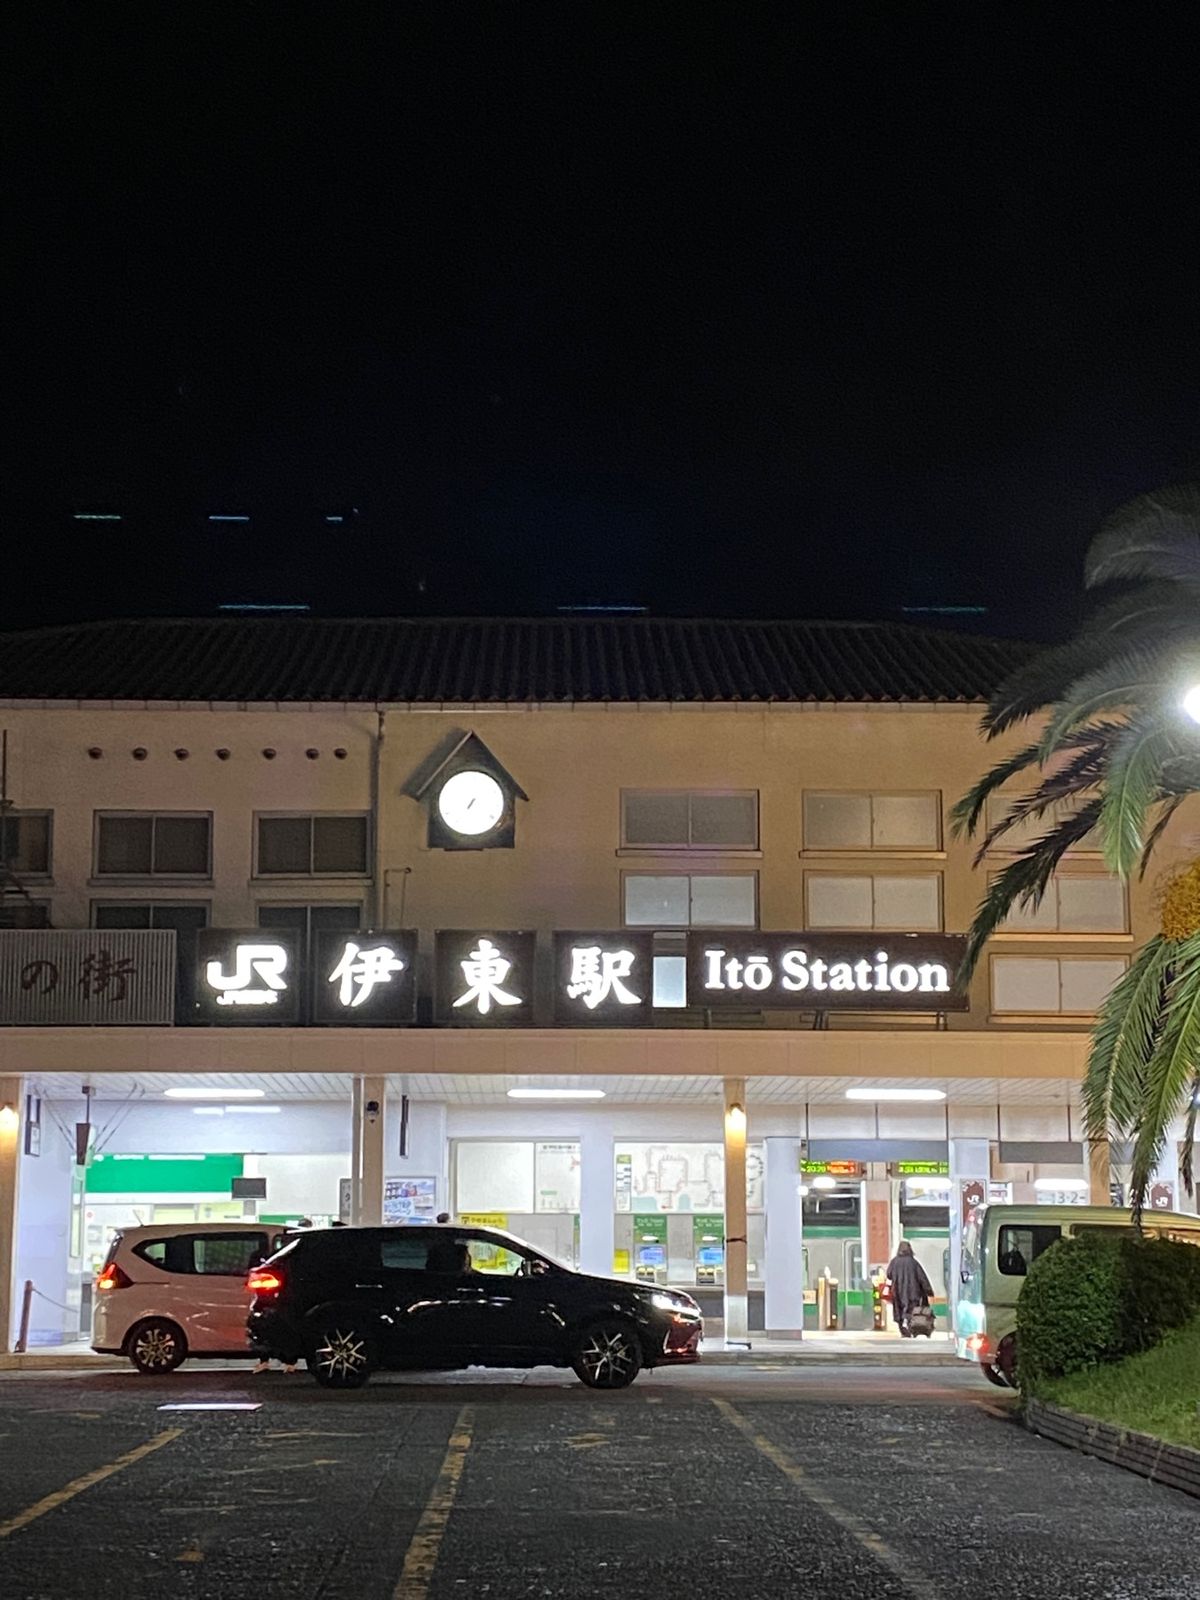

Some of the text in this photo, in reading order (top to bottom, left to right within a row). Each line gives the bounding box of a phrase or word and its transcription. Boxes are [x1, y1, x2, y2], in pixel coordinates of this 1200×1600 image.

[206, 944, 288, 989] JR
[328, 939, 642, 1014] 伊東駅
[704, 950, 951, 993] Itō Station
[967, 1194, 980, 1204] JR
[1155, 1197, 1168, 1206] JR
